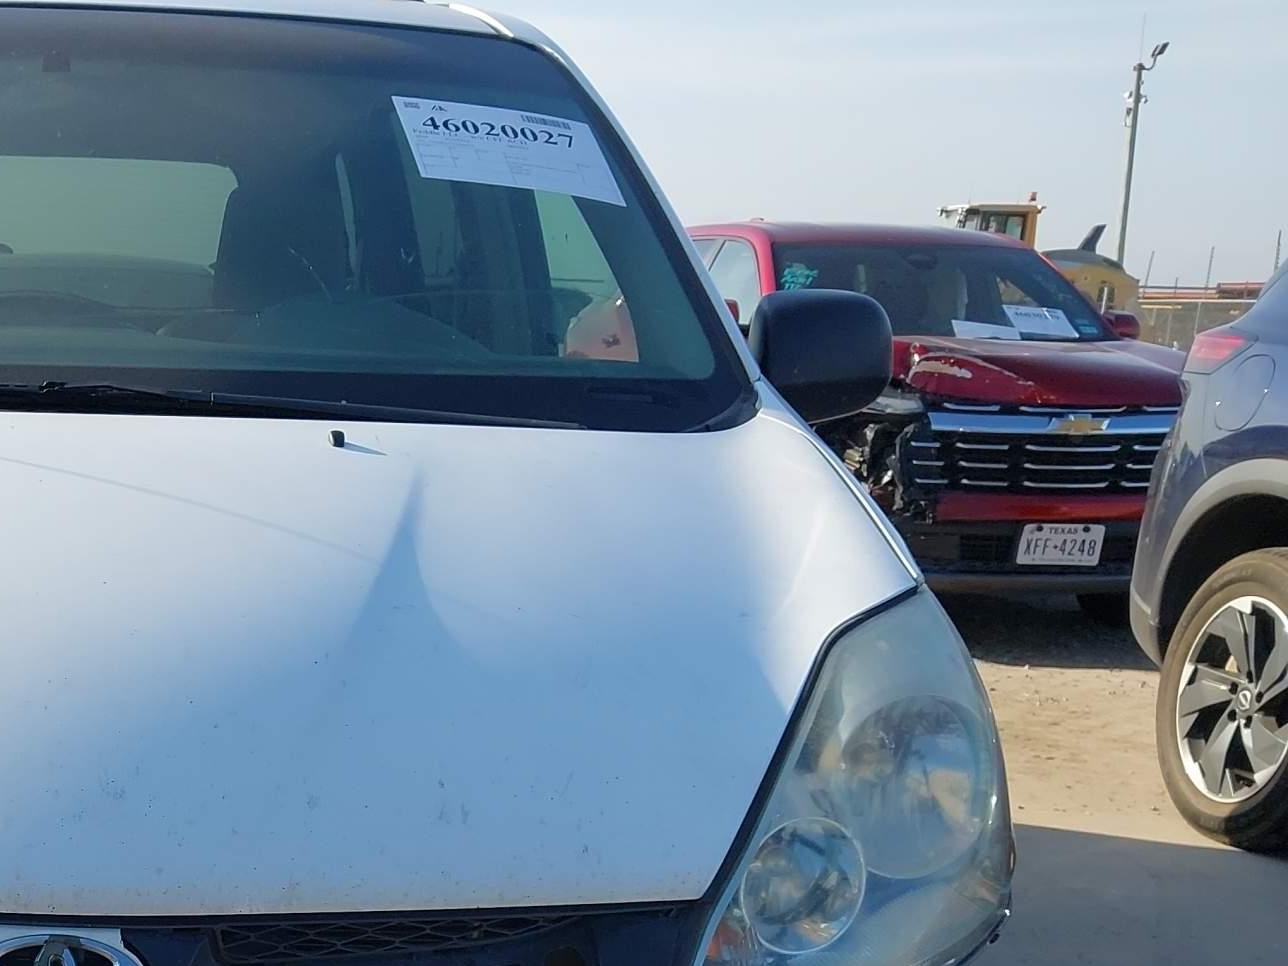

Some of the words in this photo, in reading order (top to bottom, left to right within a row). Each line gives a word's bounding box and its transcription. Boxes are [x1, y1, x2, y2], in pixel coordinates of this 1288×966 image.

[422, 116, 573, 148] 46020027
[1049, 527, 1079, 535] TEXAS
[1024, 538, 1097, 557] XFF-4248
